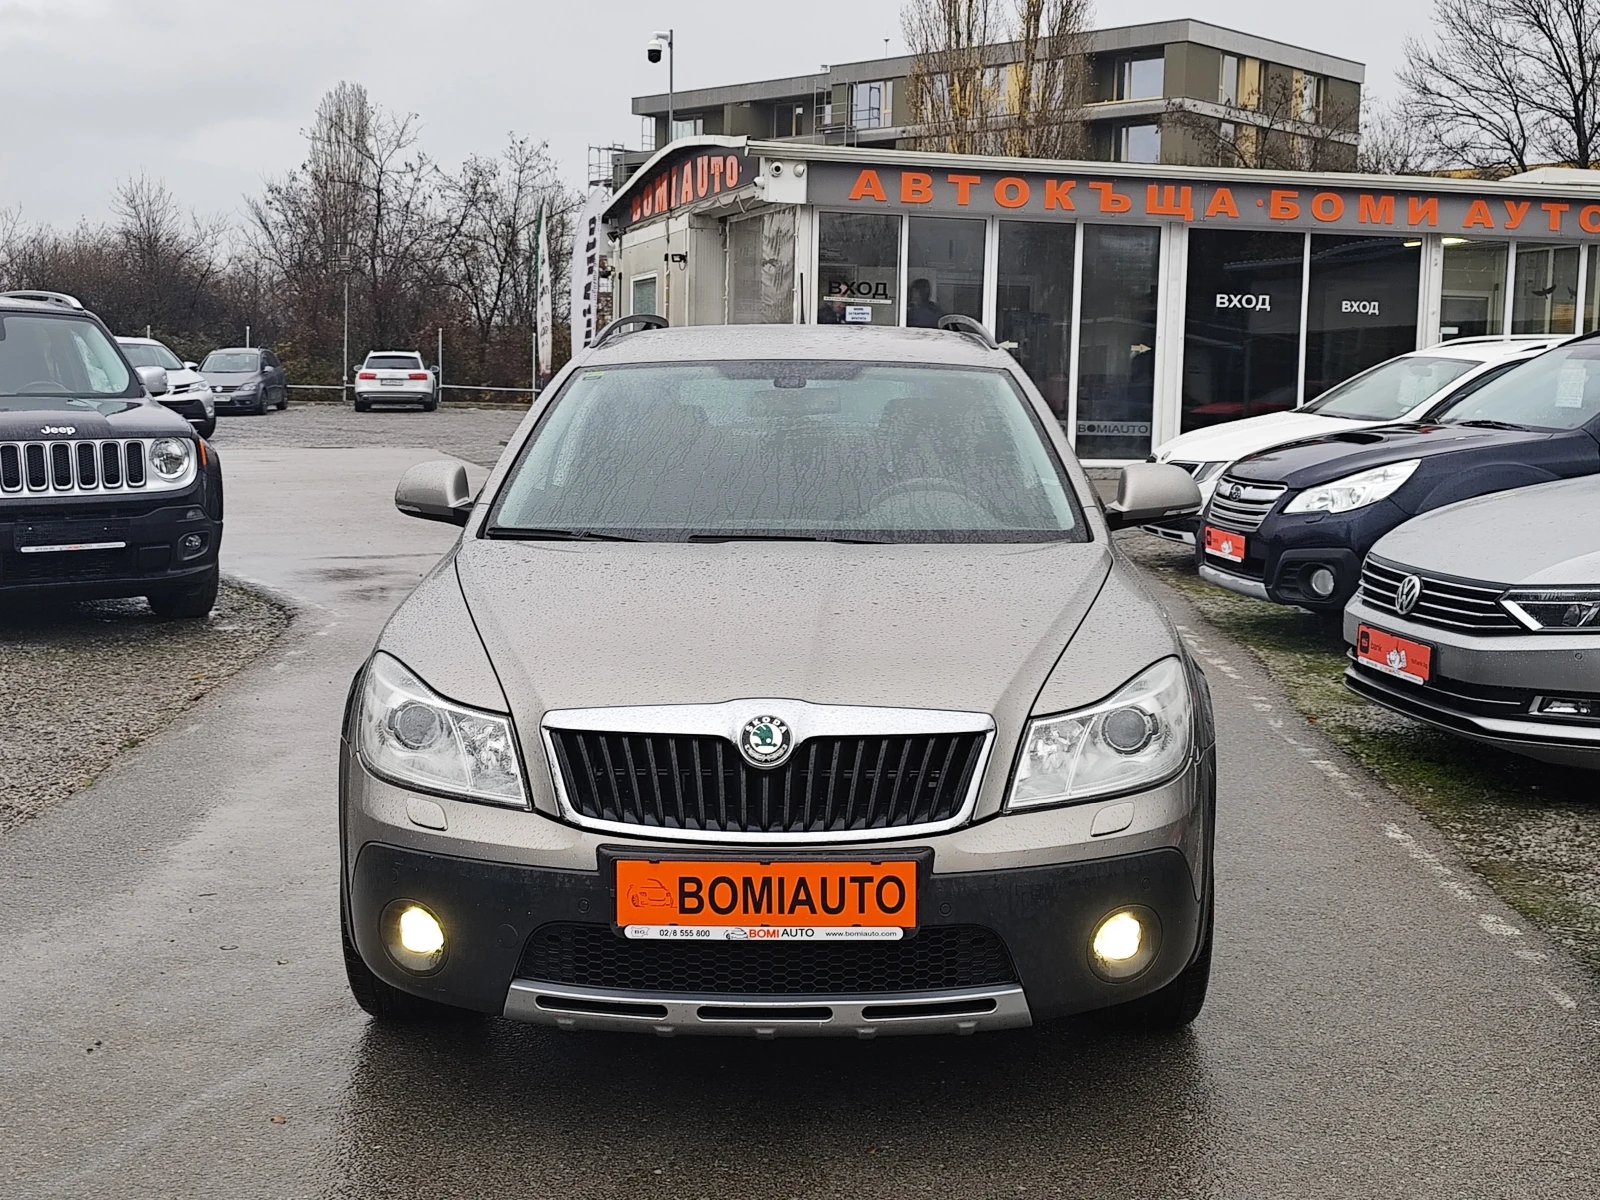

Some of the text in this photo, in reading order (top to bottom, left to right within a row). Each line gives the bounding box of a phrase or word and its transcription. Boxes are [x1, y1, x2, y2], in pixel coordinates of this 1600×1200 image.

[848, 169, 1600, 234] АВТОКЪЩА БОМИ АУТО
[828, 281, 888, 299] ВХОД
[1215, 294, 1271, 312] ВХОД
[1341, 300, 1380, 316] ВХОД
[41, 425, 76, 436] Jeep
[1078, 424, 1149, 434] BOMIAUTO
[745, 716, 788, 733] SKODA
[678, 875, 906, 915] BOMIAUTO
[659, 929, 678, 938] 02/8
[680, 929, 693, 938] 555
[696, 929, 710, 938] 800
[749, 929, 780, 938] BOMI
[781, 928, 815, 938] AUTO
[825, 930, 897, 938] www.bomiauto.com
